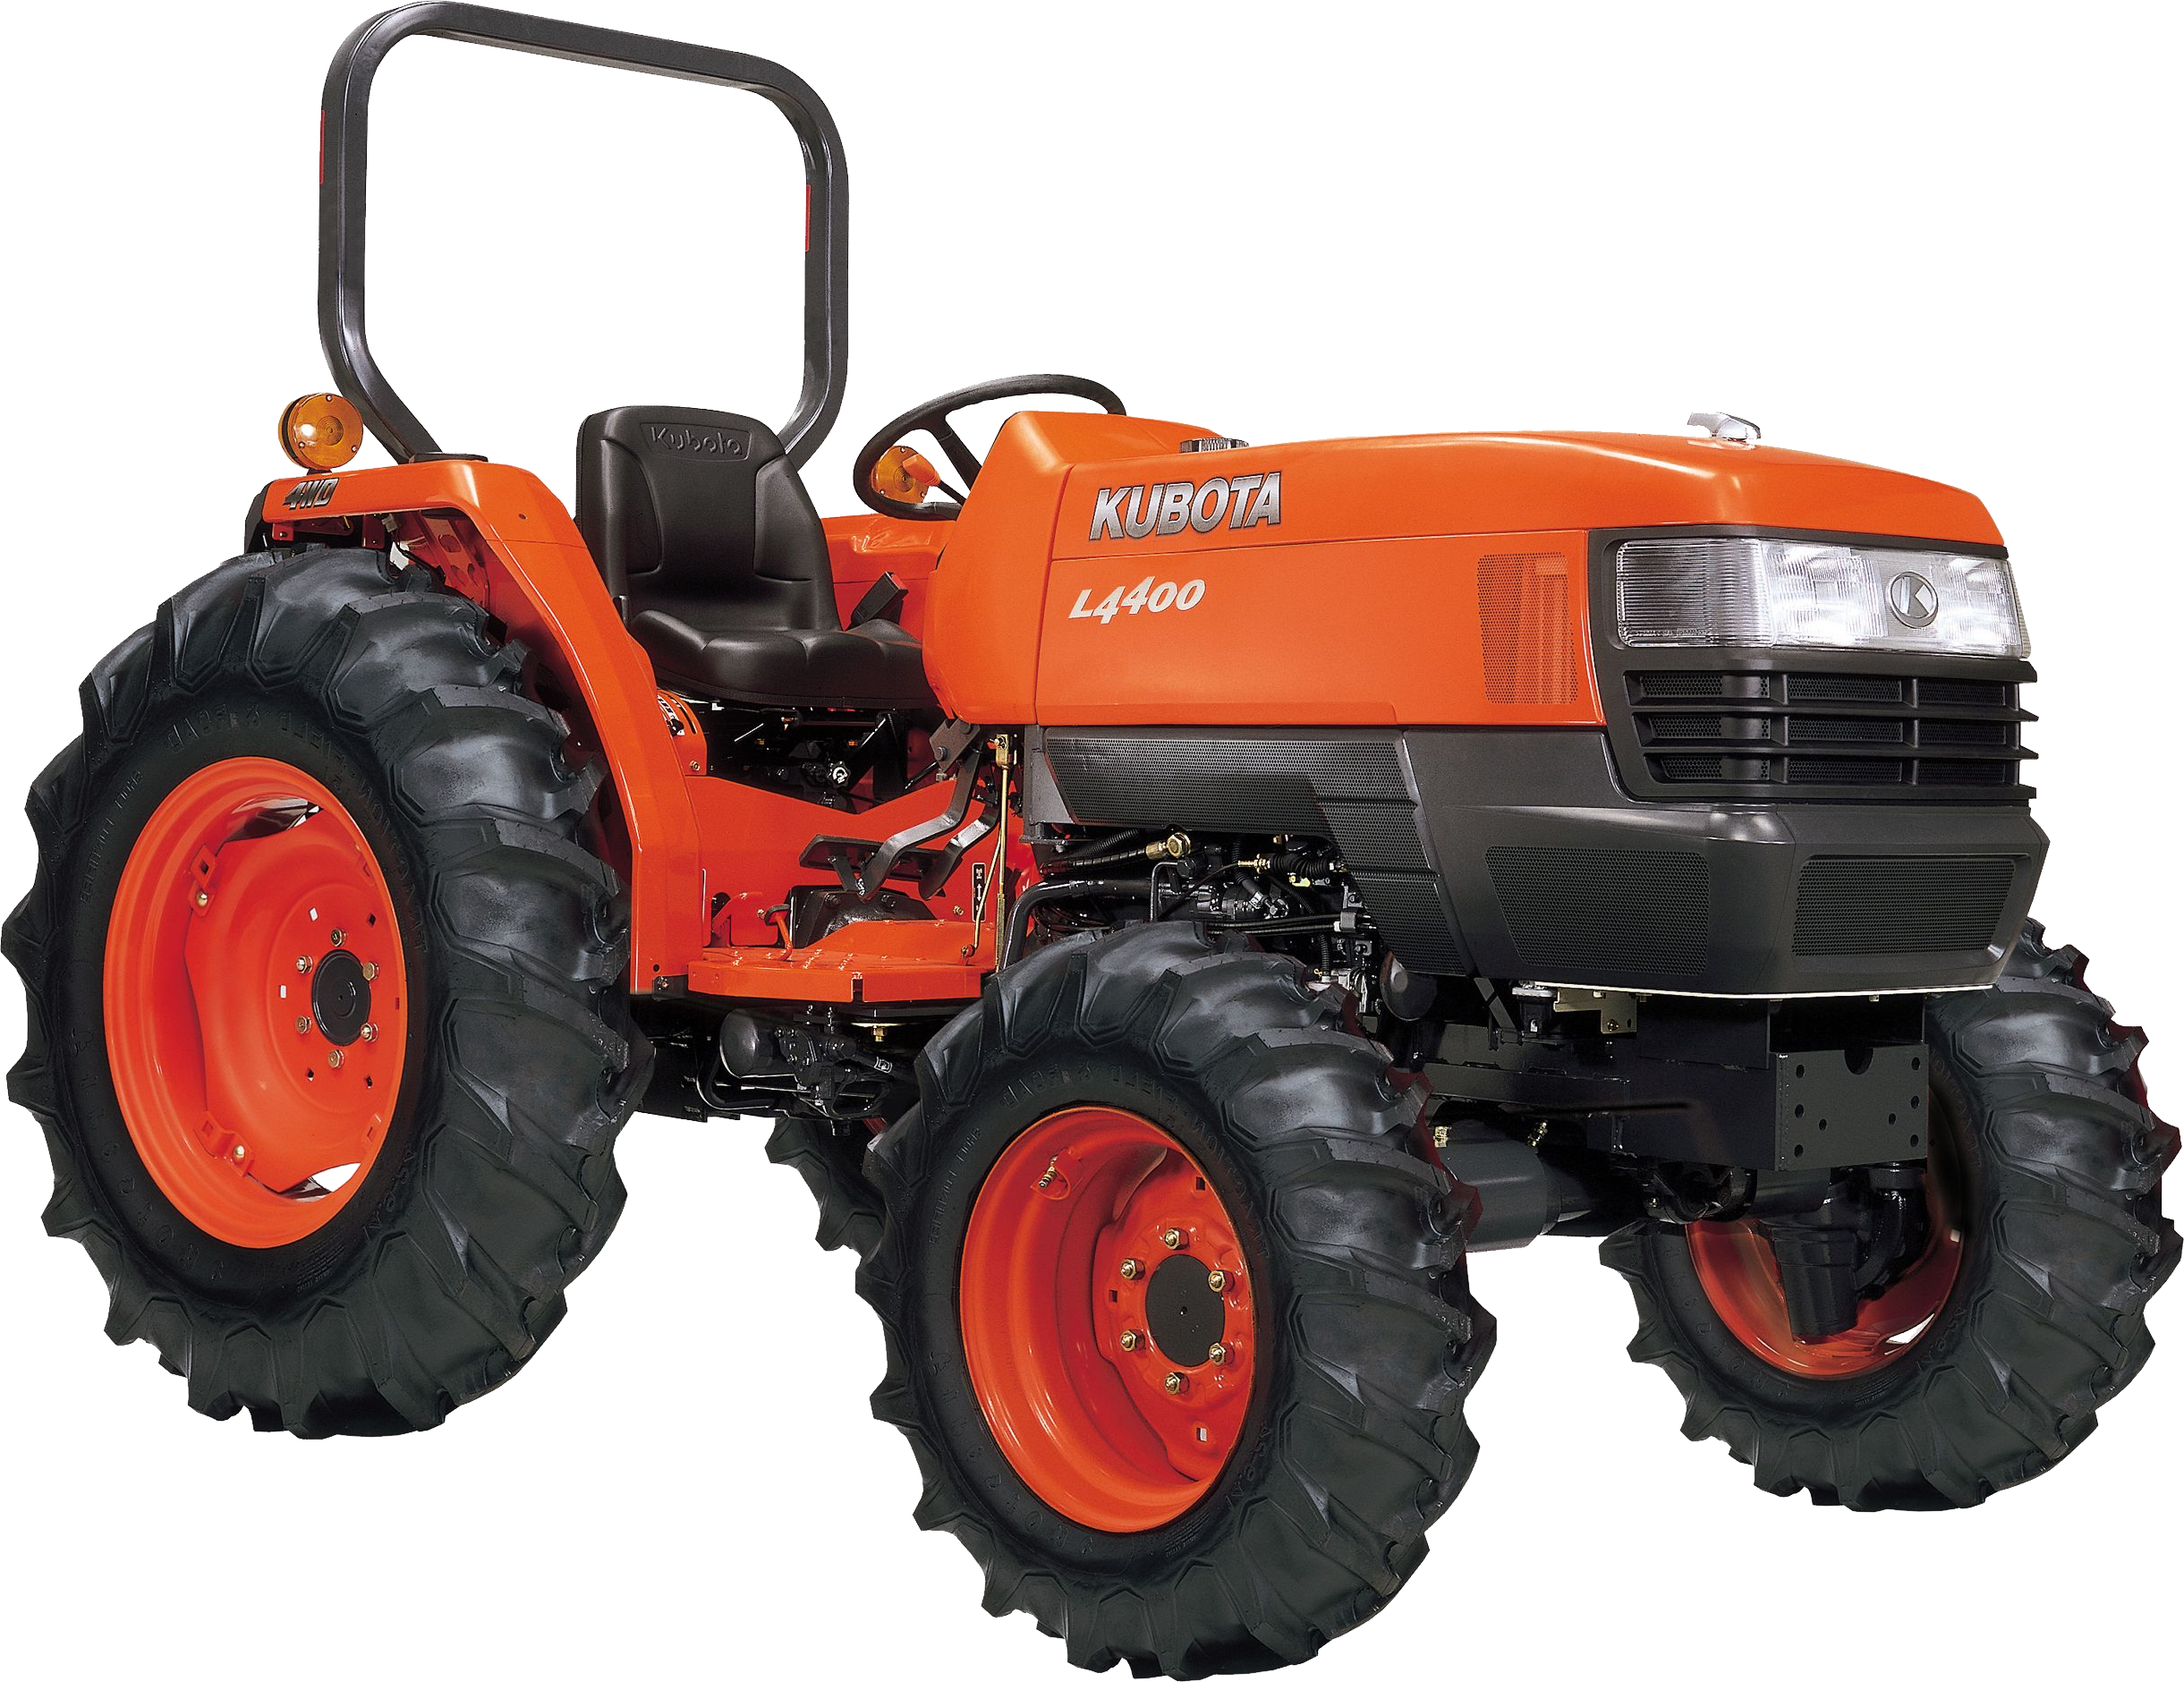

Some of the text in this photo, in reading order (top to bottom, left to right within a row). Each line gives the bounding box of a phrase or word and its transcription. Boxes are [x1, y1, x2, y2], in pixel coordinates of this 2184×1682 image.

[650, 426, 743, 455] Kubota
[283, 477, 340, 510] 4WD
[1089, 471, 1282, 541] KUBOTA
[1068, 575, 1206, 624] L4400
